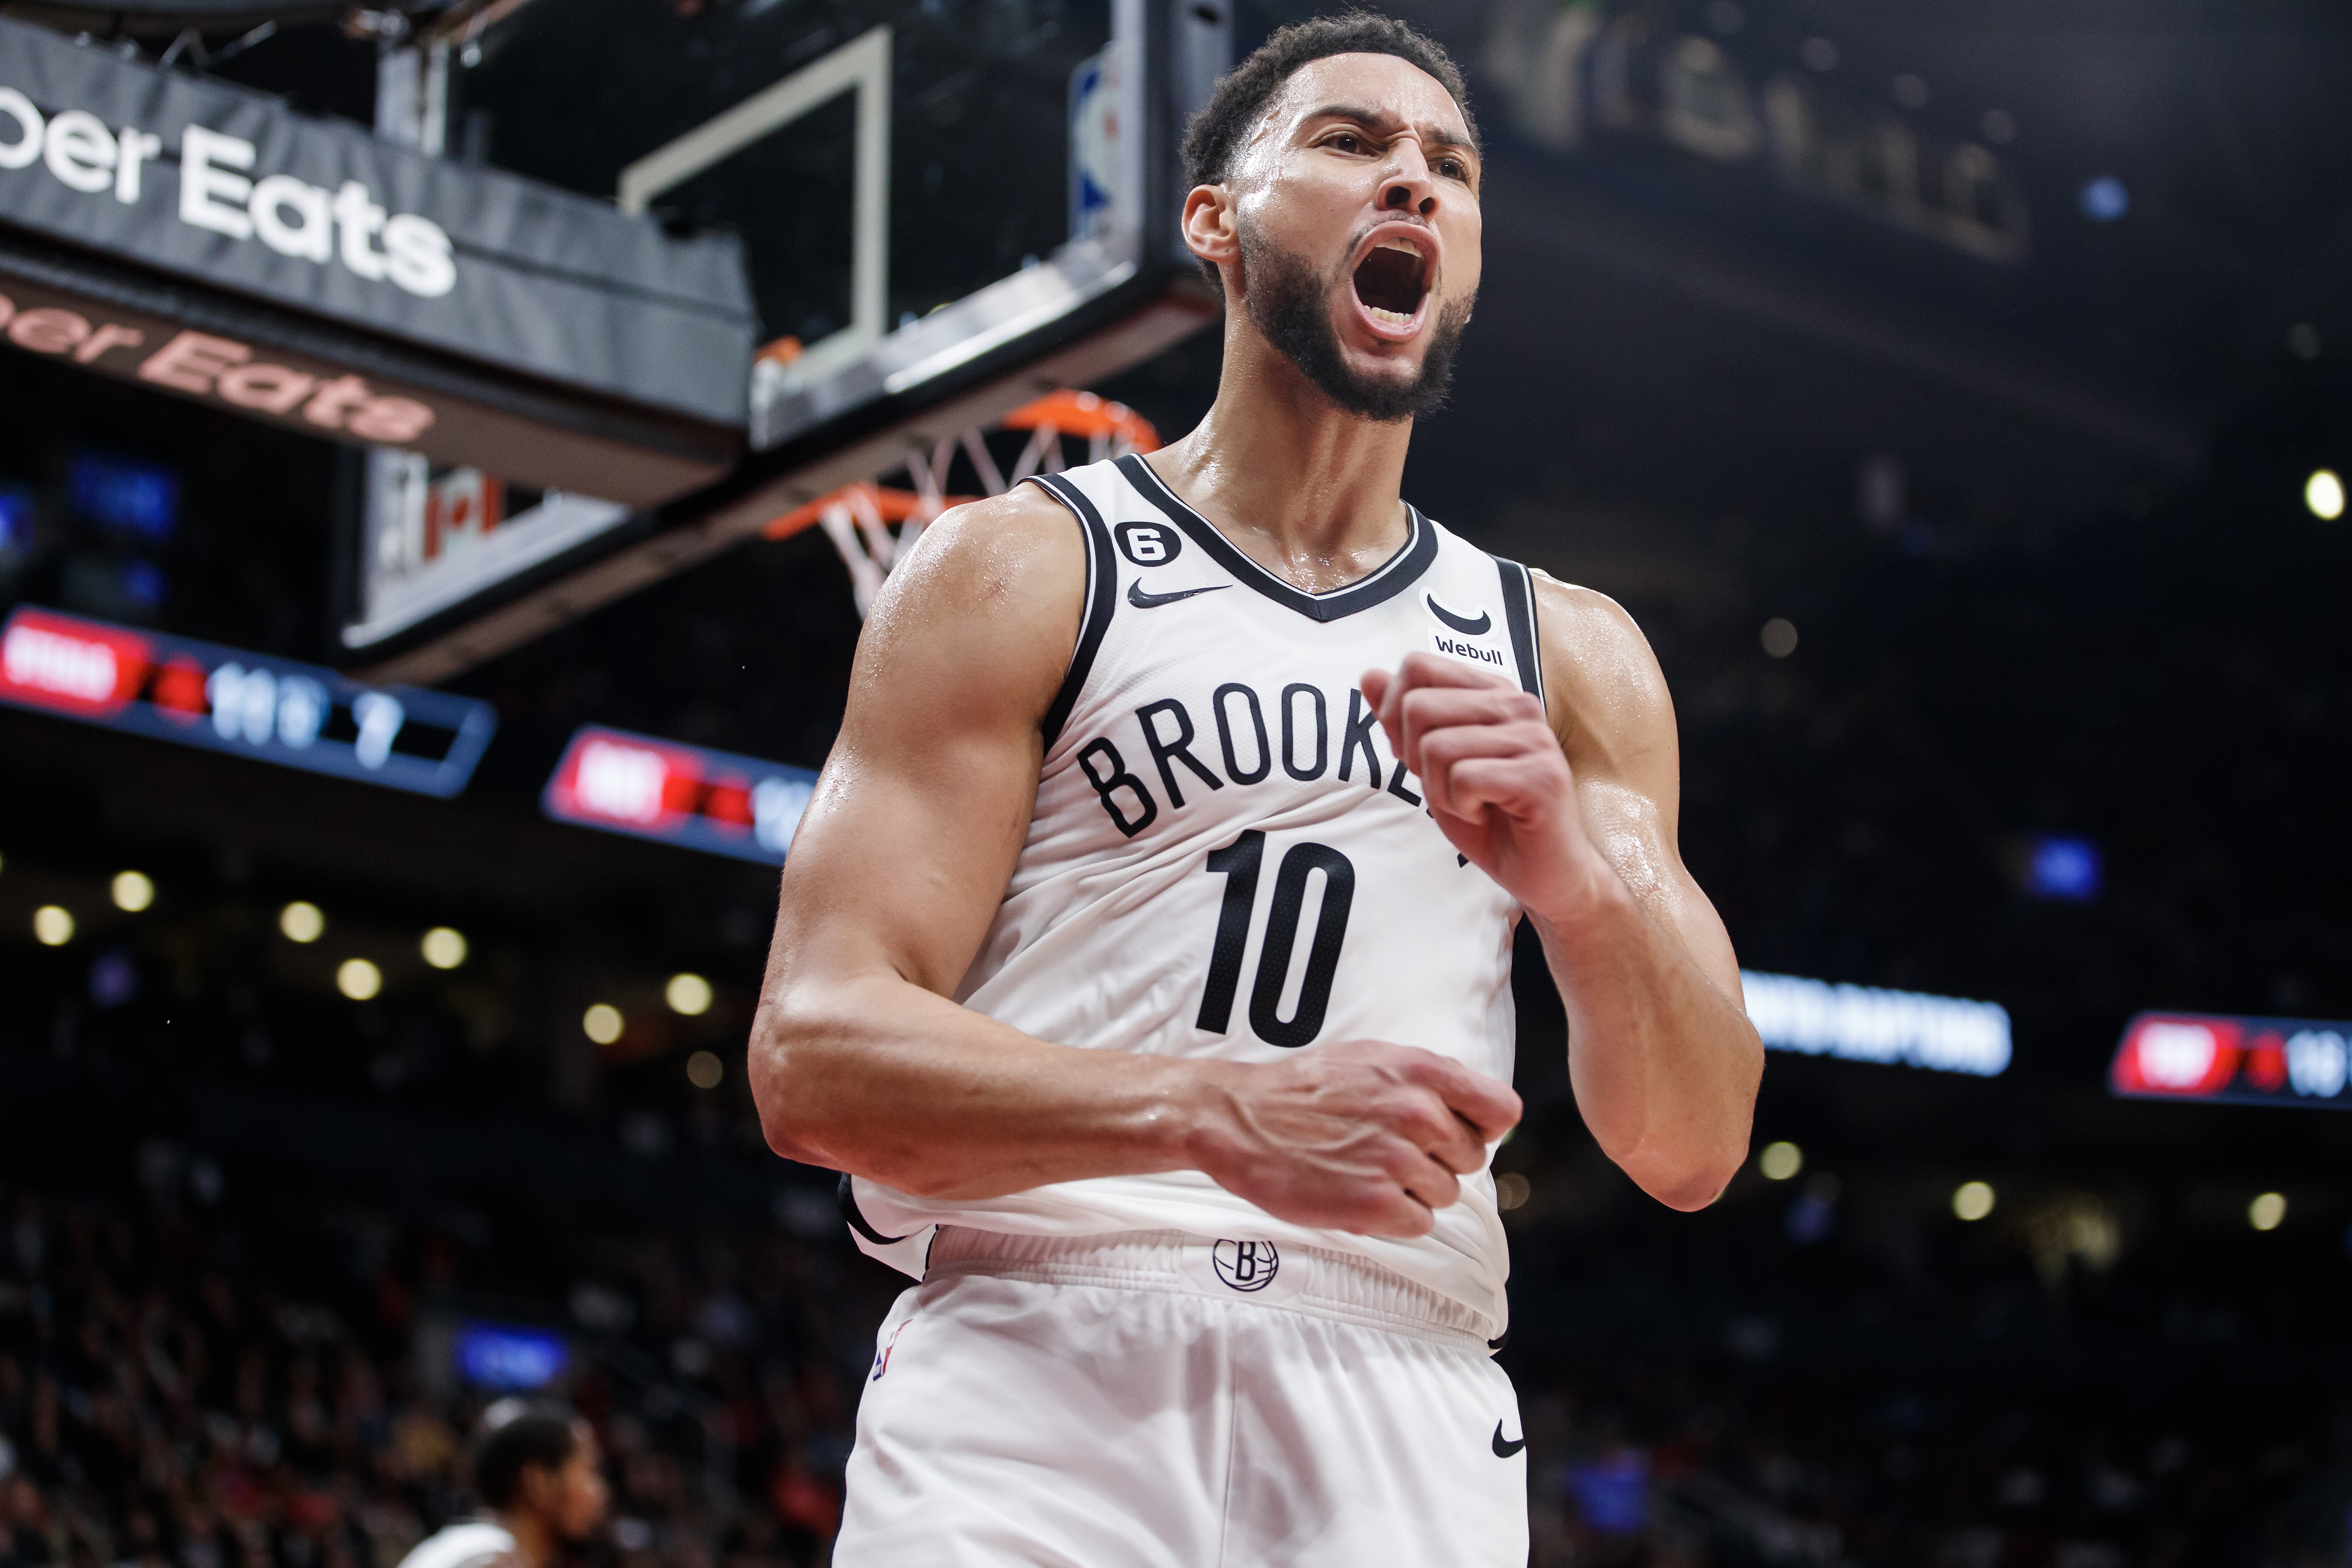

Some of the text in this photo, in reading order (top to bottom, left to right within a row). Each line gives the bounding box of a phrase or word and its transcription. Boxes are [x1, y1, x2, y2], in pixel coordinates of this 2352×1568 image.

[180, 125, 457, 297] Eats
[0, 294, 438, 443] er Eats
[1126, 528, 1167, 560] 6
[1435, 635, 1504, 666] Webull
[1195, 829, 1357, 1048] 10
[1236, 1241, 1256, 1281] B
